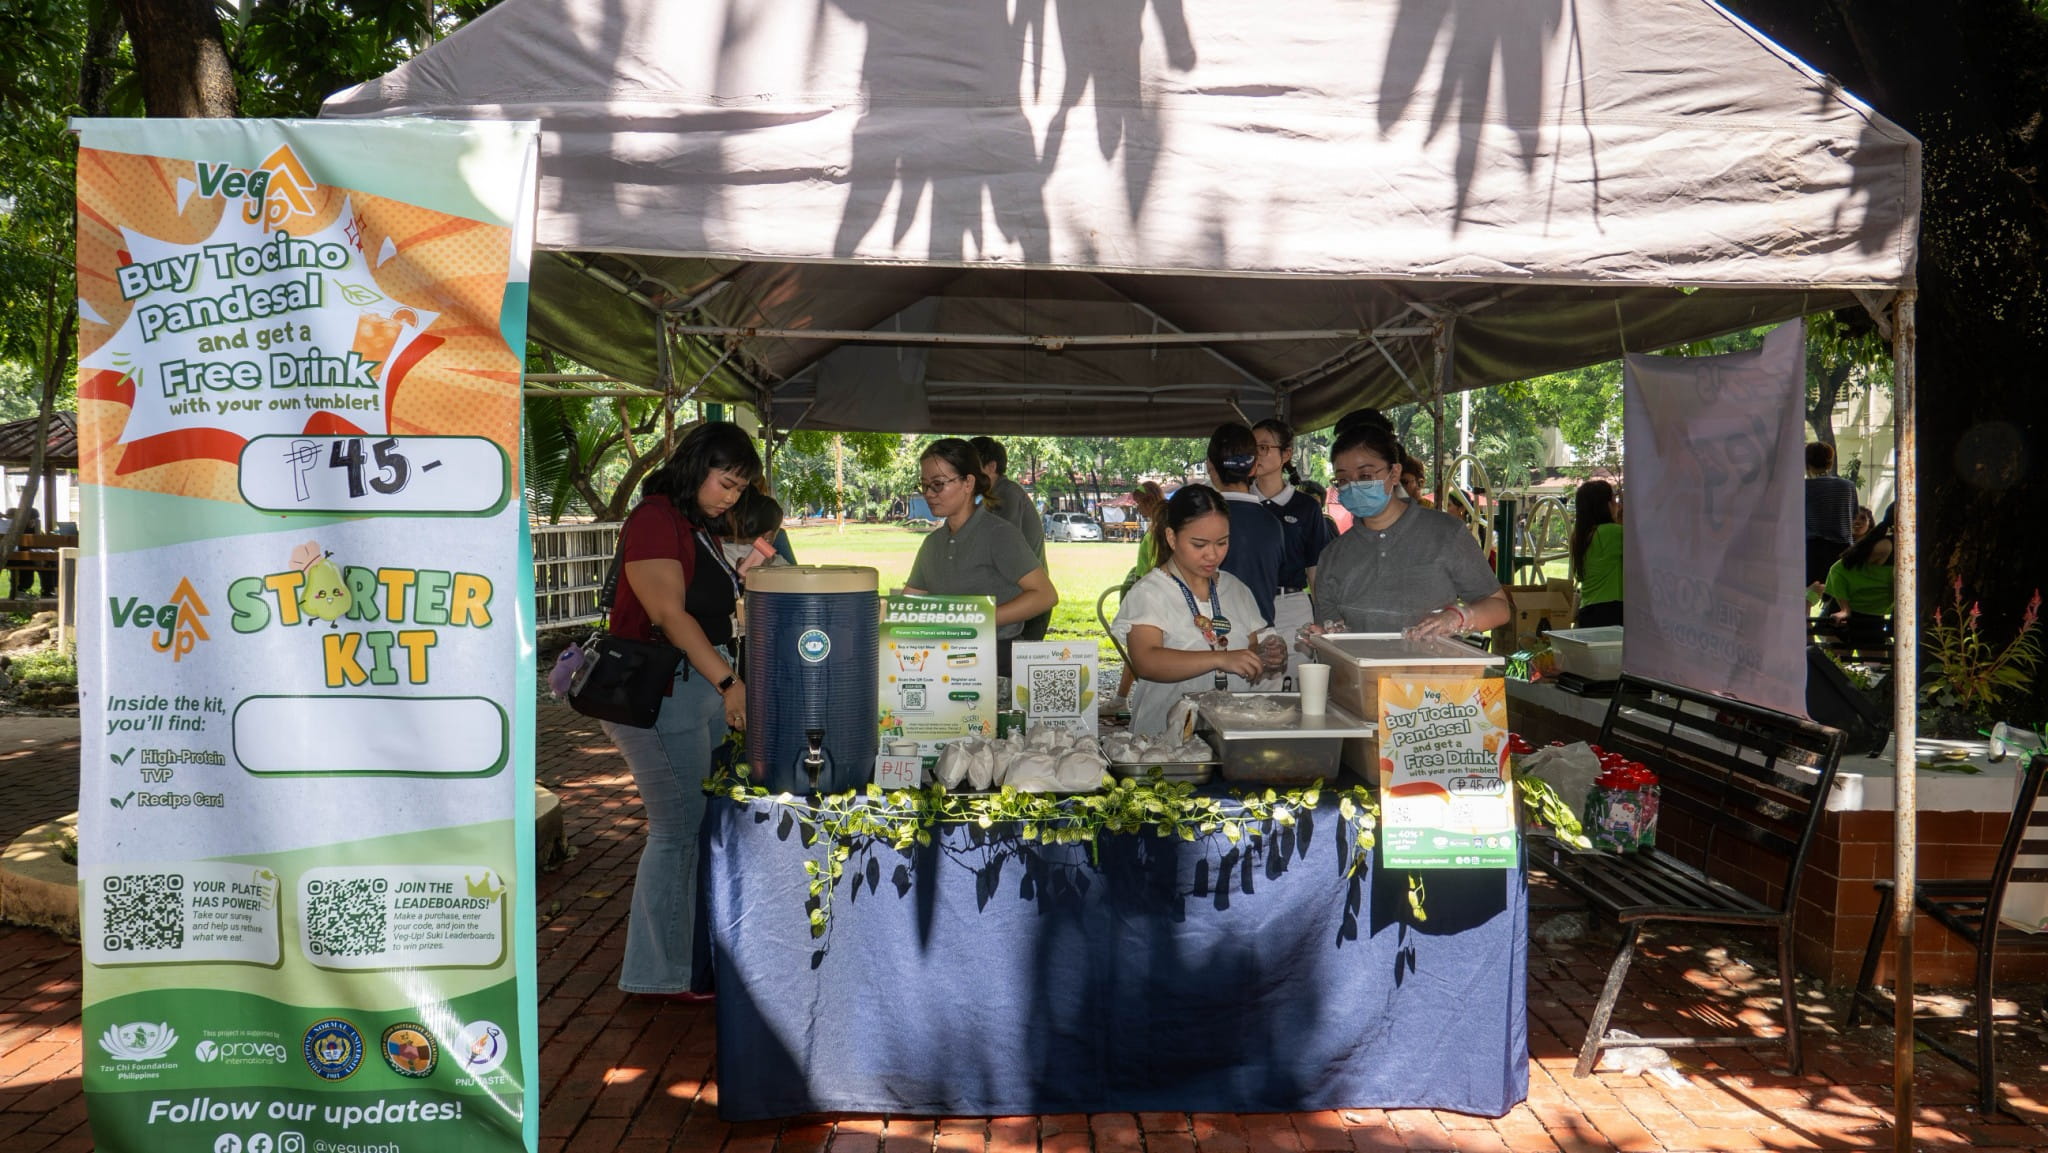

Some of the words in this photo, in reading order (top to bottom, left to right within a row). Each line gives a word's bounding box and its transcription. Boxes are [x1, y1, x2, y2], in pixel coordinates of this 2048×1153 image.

[197, 162, 271, 218] Veg
[116, 250, 200, 302] Buy
[203, 230, 349, 279] Tocino
[138, 273, 323, 343] Pandesal
[198, 328, 249, 354] and
[257, 322, 295, 351] get
[299, 326, 312, 342] a
[160, 359, 263, 398] Free
[269, 347, 382, 390] Drink
[170, 396, 211, 416] with
[217, 398, 262, 416] your
[268, 396, 301, 411] own
[304, 393, 381, 412] tumbler!
[227, 567, 494, 634] STRTER
[889, 603, 944, 612] VEG-UP!
[948, 603, 979, 612] SUKI
[108, 596, 179, 648] Veg
[322, 630, 437, 688] KIT
[1425, 690, 1441, 703] Veg
[107, 696, 169, 712] Inside
[174, 696, 200, 712] the
[203, 696, 227, 715] kit,
[1385, 712, 1417, 730] Buy
[1418, 703, 1477, 722] Tocino
[106, 715, 163, 736] you'll
[168, 715, 207, 732] find:
[1393, 719, 1471, 747] Pandesal
[1413, 742, 1432, 753] and
[1434, 739, 1453, 751] get
[1456, 740, 1462, 748] a
[140, 749, 227, 767] High-Protein
[1404, 753, 1444, 769] Free
[1446, 749, 1498, 765] Drink
[140, 768, 174, 783] TVP
[1410, 769, 1426, 777] with
[1428, 768, 1445, 776] your
[1464, 766, 1498, 774] tumbler!
[138, 792, 191, 809] Recipe
[194, 792, 225, 808] Card
[193, 881, 226, 893] YOUR
[231, 882, 262, 897] PLATE
[394, 882, 427, 894] JOIN
[428, 882, 453, 894] THE
[192, 896, 219, 908] HAS
[221, 897, 261, 911] POWER!
[394, 897, 490, 910] LEADEBOARDS!
[193, 910, 214, 919] Take
[214, 911, 229, 919] our
[230, 913, 253, 923] survey
[394, 912, 416, 920] Make
[424, 912, 461, 922] purchase,
[462, 912, 481, 920] enter
[192, 921, 209, 930] and
[210, 921, 229, 932] help
[230, 923, 240, 931] us
[240, 923, 263, 933] rethink
[393, 922, 411, 932] your
[412, 921, 434, 931] code,
[436, 921, 450, 930] and
[450, 921, 466, 931] join
[467, 921, 479, 930] the
[192, 933, 214, 942] what
[216, 934, 228, 942] we
[393, 932, 425, 942] Veg-Up!
[426, 931, 443, 940] Suki
[444, 931, 496, 940] Leaderboards
[392, 943, 401, 951] to
[403, 943, 418, 951] win
[220, 1041, 288, 1064] proveg
[100, 1064, 115, 1073] Tzu
[116, 1063, 130, 1072] Chi
[131, 1062, 178, 1071] Foundation
[225, 1057, 274, 1065] international
[118, 1071, 160, 1080] Philippines
[455, 1078, 475, 1087] PNU
[476, 1075, 506, 1086] ASTE
[148, 1097, 261, 1125] Follow
[267, 1101, 317, 1121] our
[324, 1099, 463, 1129] updates!
